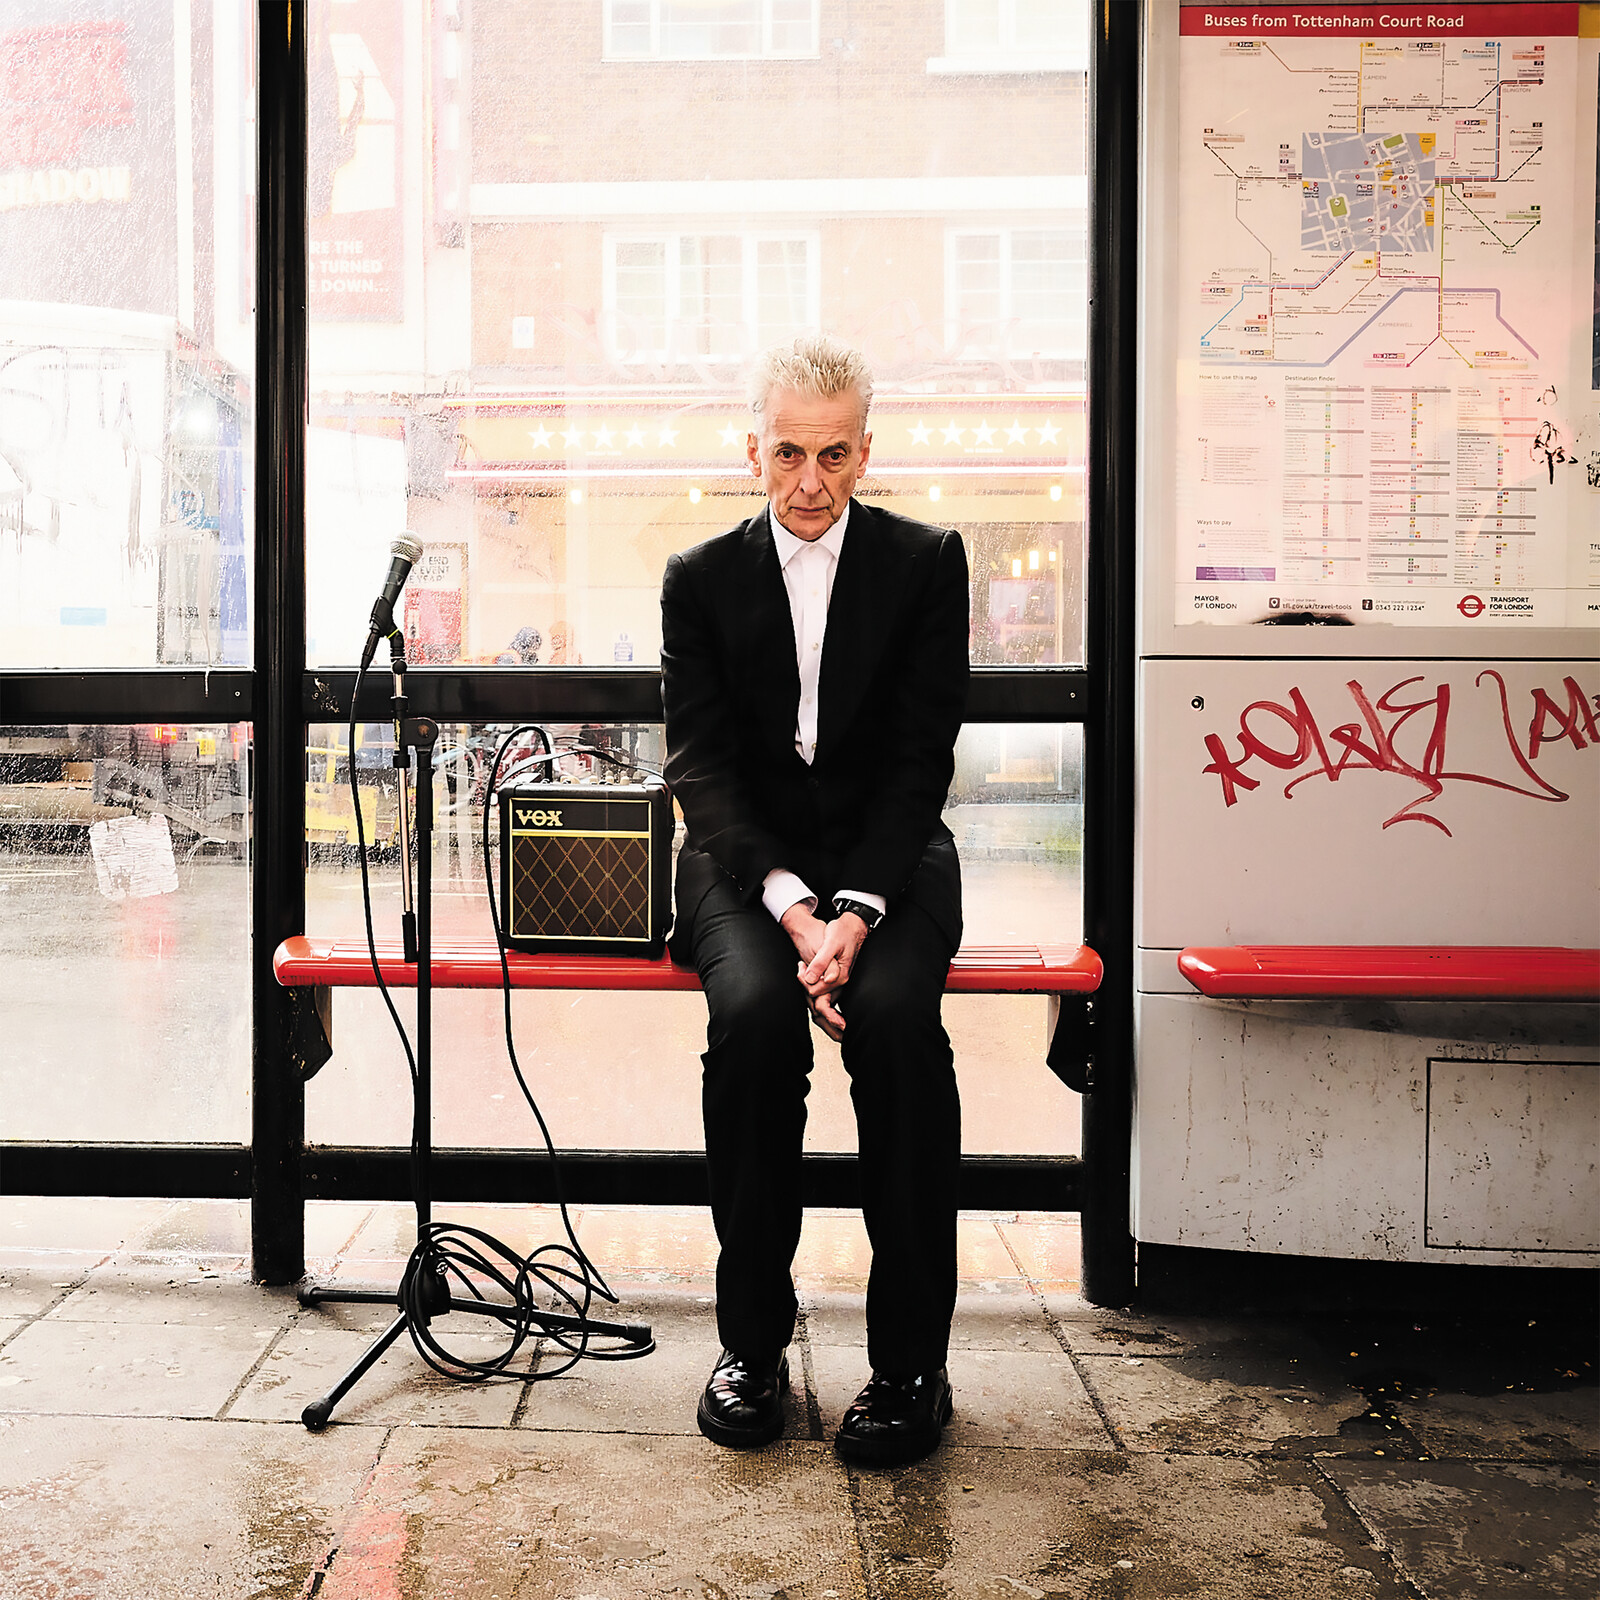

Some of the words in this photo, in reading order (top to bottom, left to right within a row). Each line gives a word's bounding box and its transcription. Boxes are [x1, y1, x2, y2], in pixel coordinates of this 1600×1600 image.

[1204, 14, 1248, 27] Buses
[1252, 14, 1287, 27] from
[1292, 14, 1374, 28] Tottenham
[1379, 15, 1422, 28] Court
[1426, 15, 1464, 28] Road
[334, 240, 363, 254] THE
[320, 260, 382, 273] TURNED
[429, 556, 448, 565] END
[420, 566, 449, 574] EVENT
[515, 809, 563, 827] VOX
